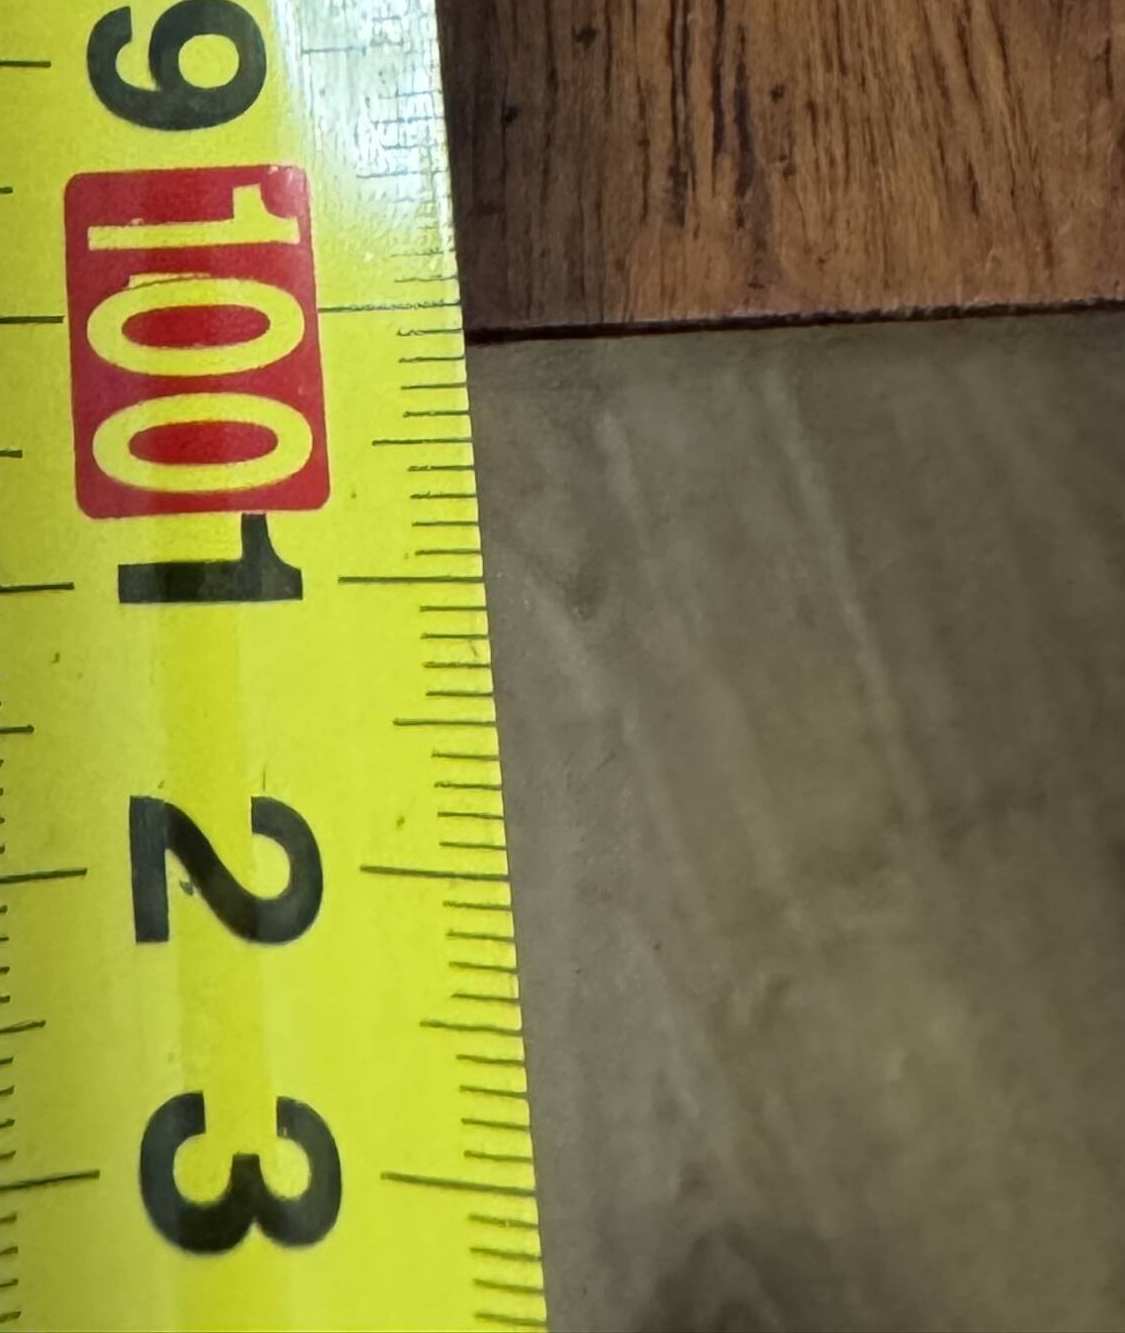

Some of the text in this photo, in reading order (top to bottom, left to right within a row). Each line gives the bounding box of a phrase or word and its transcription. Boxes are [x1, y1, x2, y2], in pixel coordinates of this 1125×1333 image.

[86, 183, 315, 495] 100
[117, 513, 304, 605] 1
[128, 794, 325, 946] 2
[138, 1090, 343, 1257] 3
